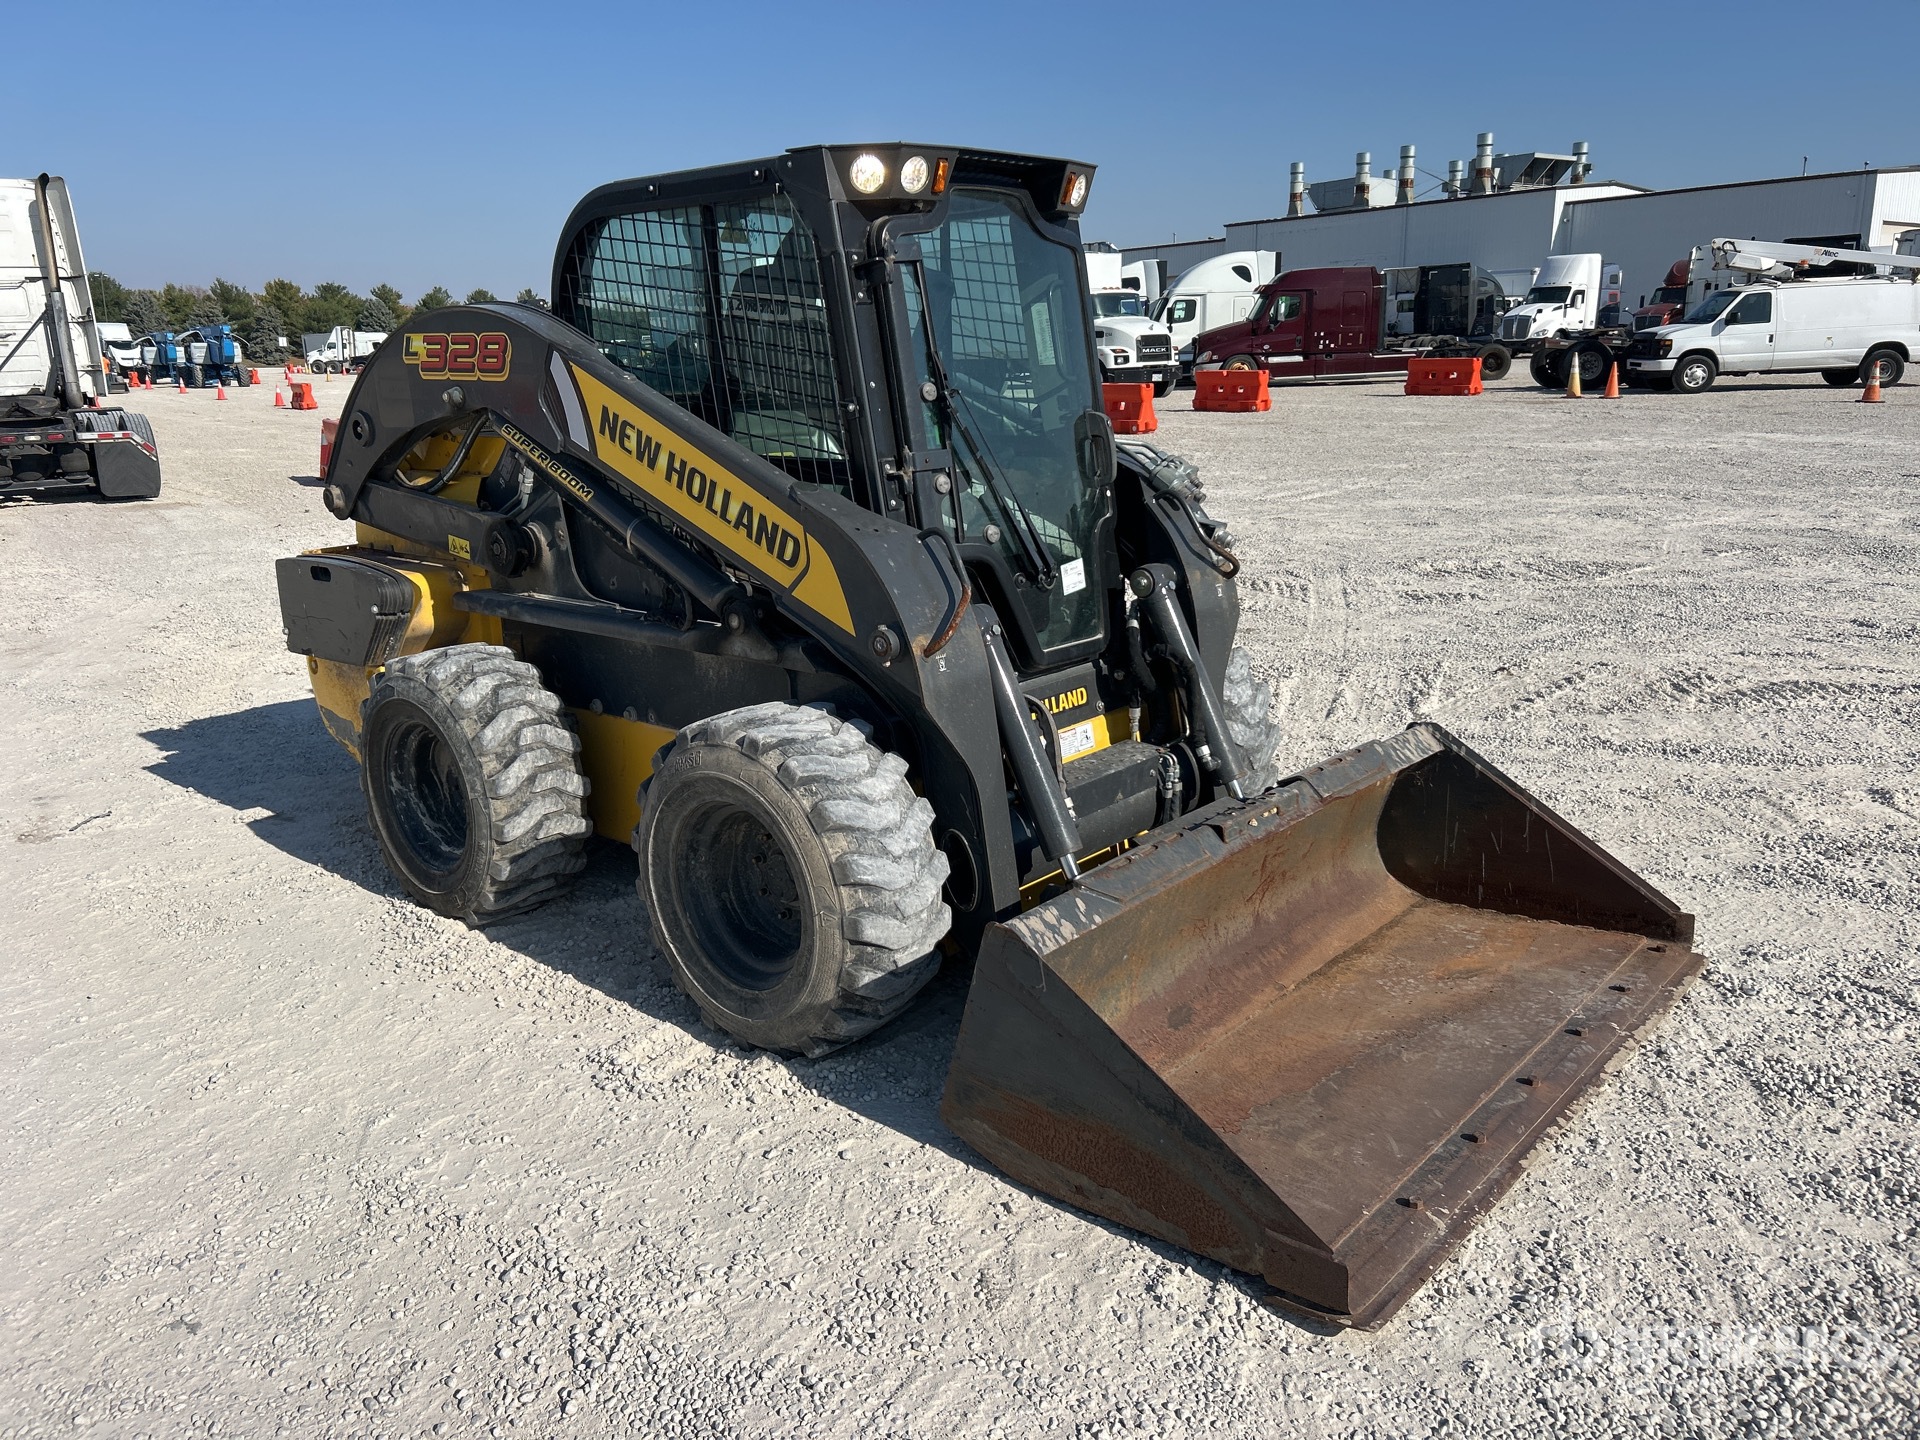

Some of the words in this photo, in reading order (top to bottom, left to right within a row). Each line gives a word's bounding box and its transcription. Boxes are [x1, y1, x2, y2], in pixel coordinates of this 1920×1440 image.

[1821, 249, 1839, 258] Altec
[403, 333, 511, 381] L328
[599, 404, 662, 472] NEW
[664, 449, 801, 570] HOLLAND
[1040, 686, 1088, 715] LLAND
